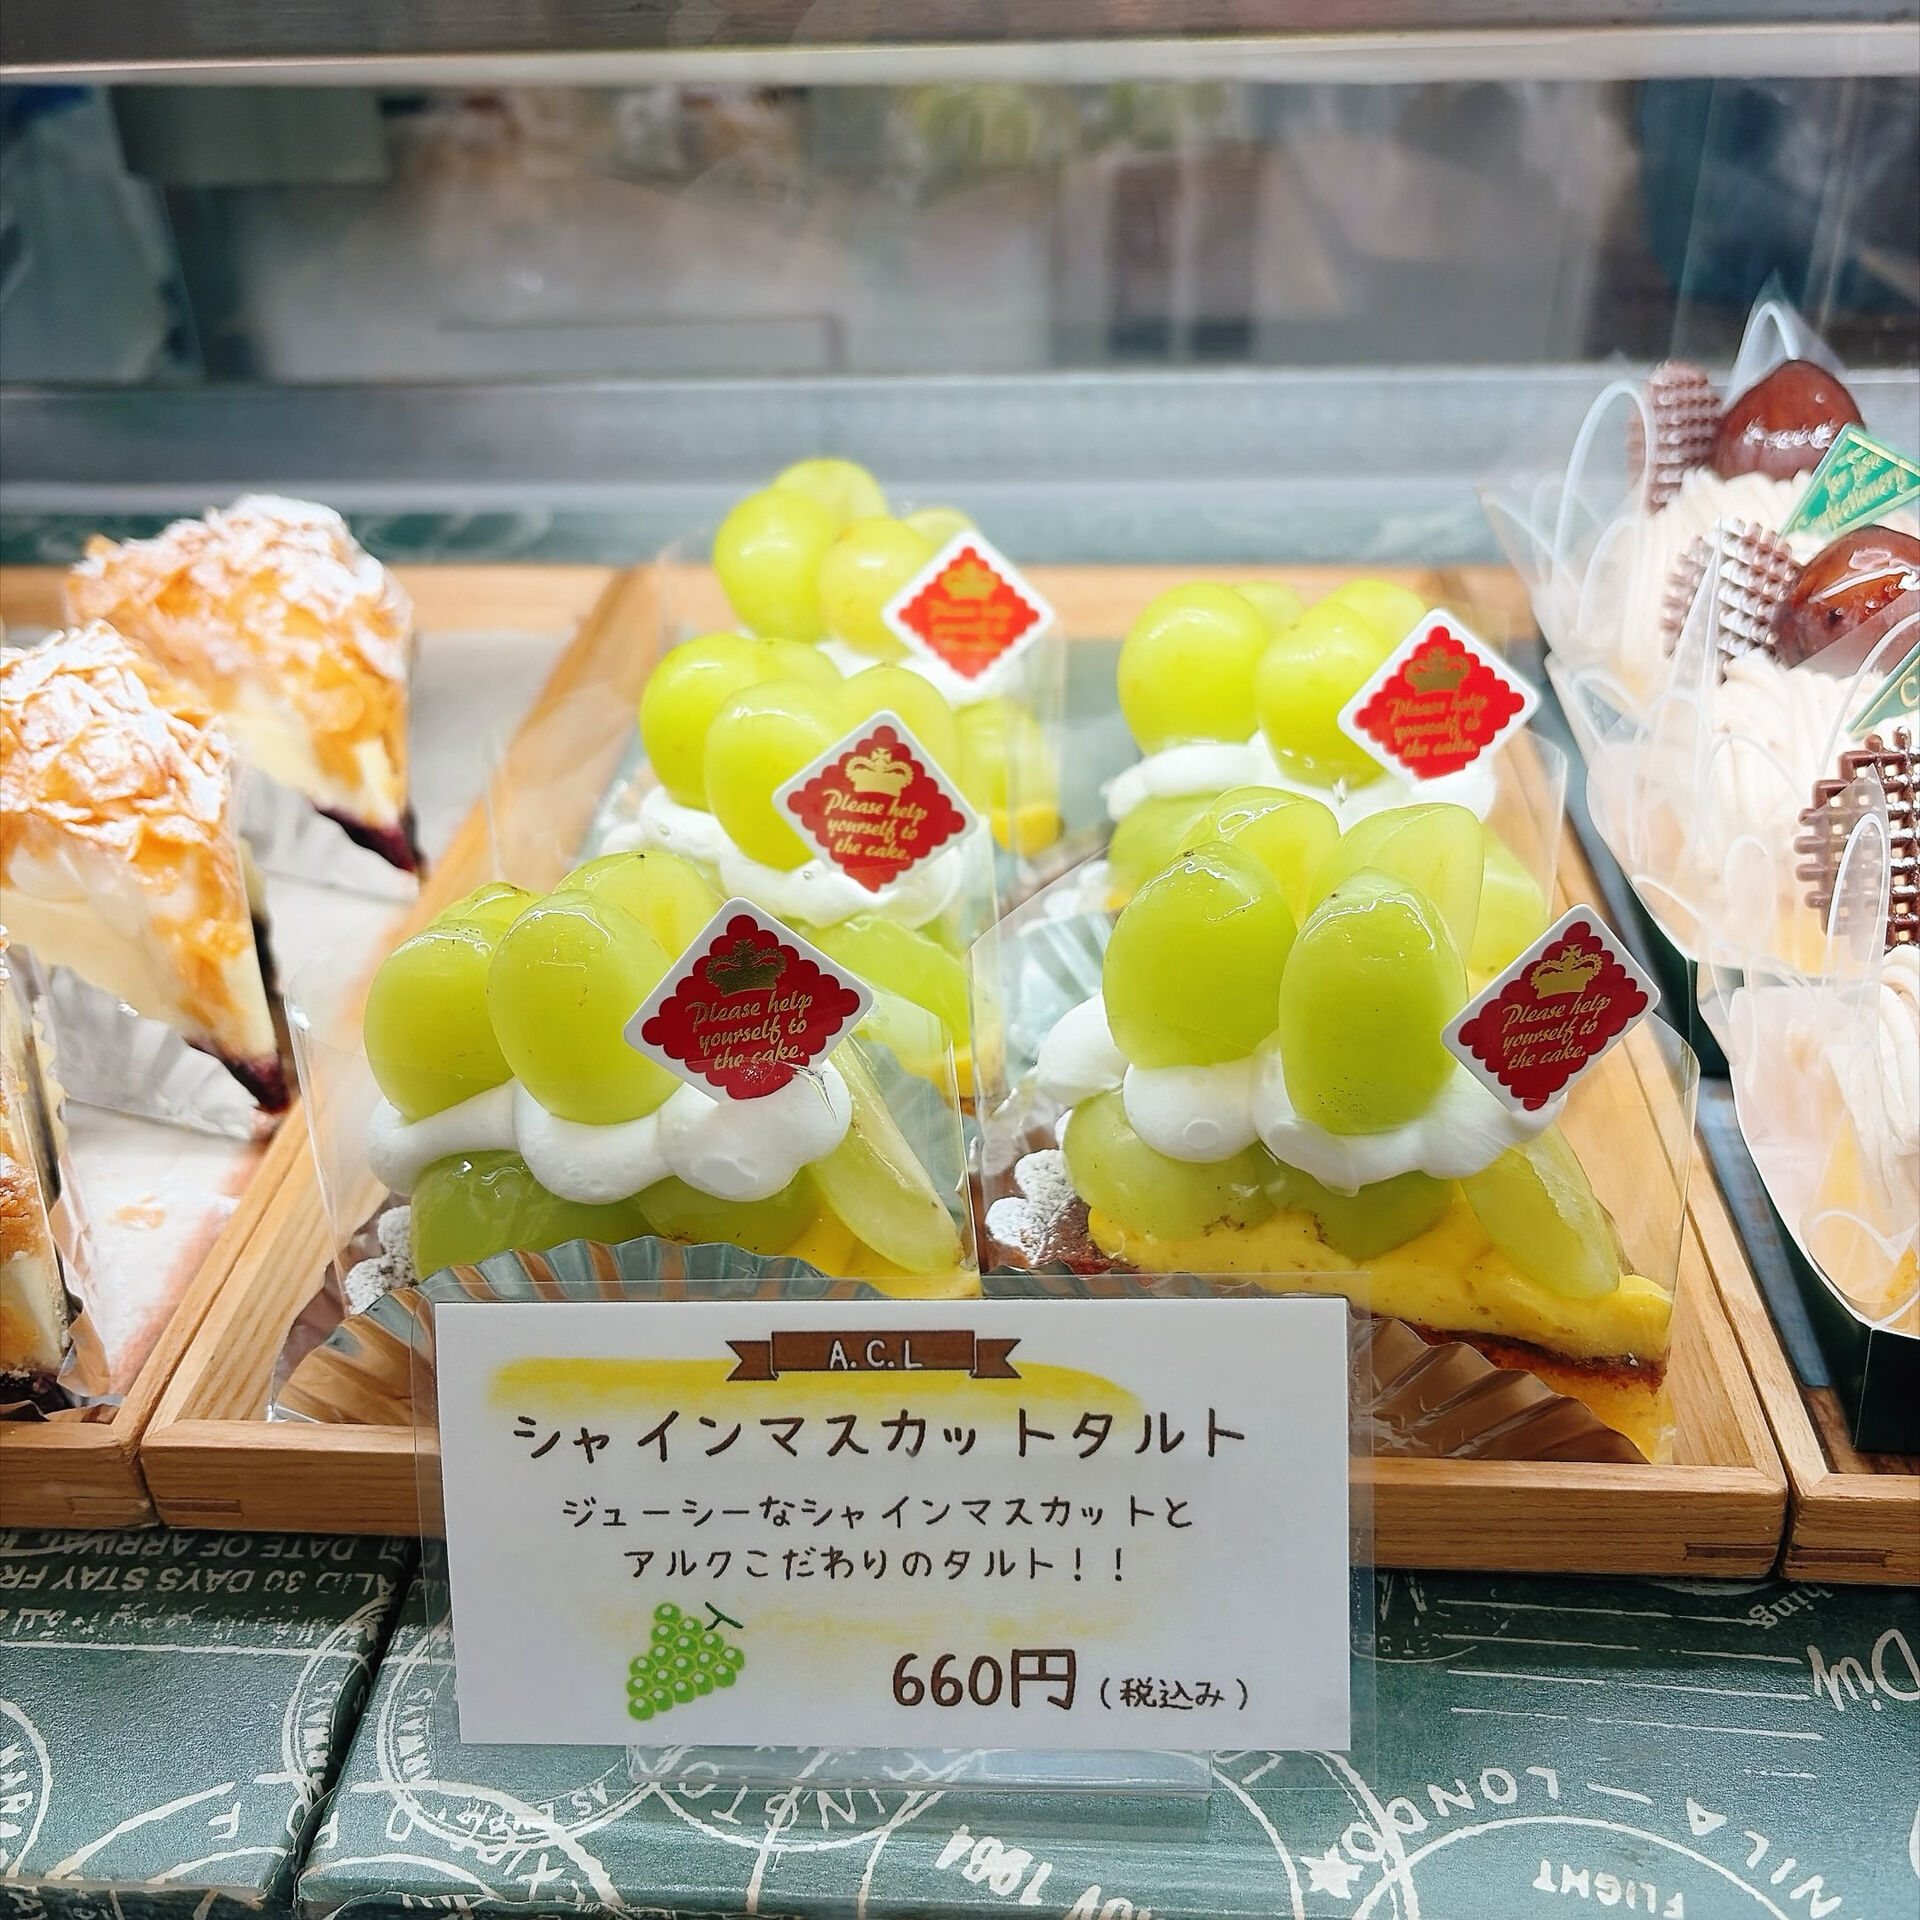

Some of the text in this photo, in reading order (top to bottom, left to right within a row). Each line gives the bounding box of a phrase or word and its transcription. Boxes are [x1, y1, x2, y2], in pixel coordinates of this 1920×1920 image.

[822, 788, 928, 827] Please help
[827, 814, 918, 844] yourself to
[834, 835, 862, 856] the
[685, 990, 813, 1034] Please help
[1501, 992, 1611, 1034] Please help
[699, 1014, 807, 1057] yourself to
[1503, 1016, 1599, 1056] yourself to
[713, 1049, 743, 1071] the
[1507, 1039, 1587, 1071] the cake.
[829, 1339, 923, 1370] A.C.L
[513, 1406, 1246, 1464] シャインマスカットタルト
[562, 1495, 1193, 1529] ジューシーなシャインマスカットと
[199, 1534, 253, 1558] OF
[260, 1535, 360, 1560] DATE
[51, 1565, 150, 1591] STAY
[157, 1567, 256, 1593] DAYS
[892, 1648, 1077, 1711] 660円
[1531, 1860, 1685, 1919] FLIGHT
